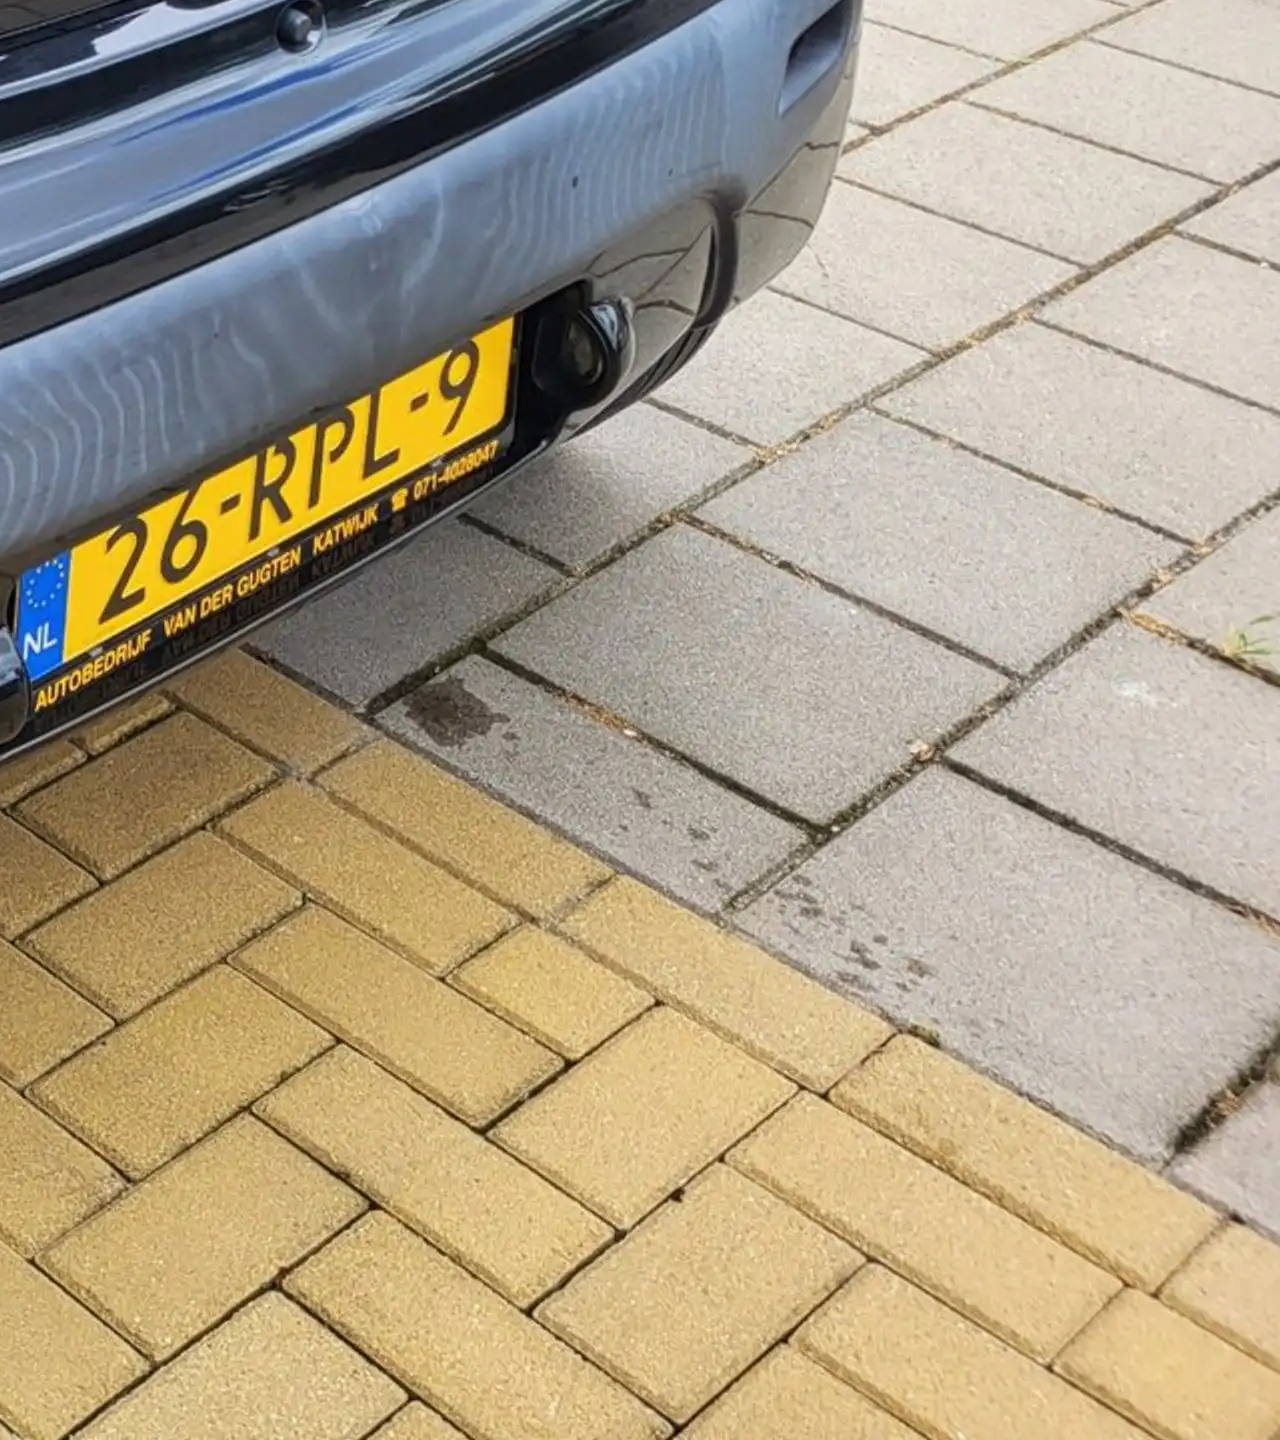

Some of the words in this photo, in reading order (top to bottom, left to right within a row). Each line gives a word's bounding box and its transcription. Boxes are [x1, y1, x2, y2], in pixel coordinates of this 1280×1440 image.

[98, 339, 480, 626] 26-RPL-9
[23, 622, 58, 660] NL
[34, 628, 152, 712] AUTOBEDRIJF
[163, 602, 198, 638] VAN
[200, 583, 234, 619] DER
[236, 545, 302, 597] GUGTEN
[312, 502, 380, 557] KATWIJK
